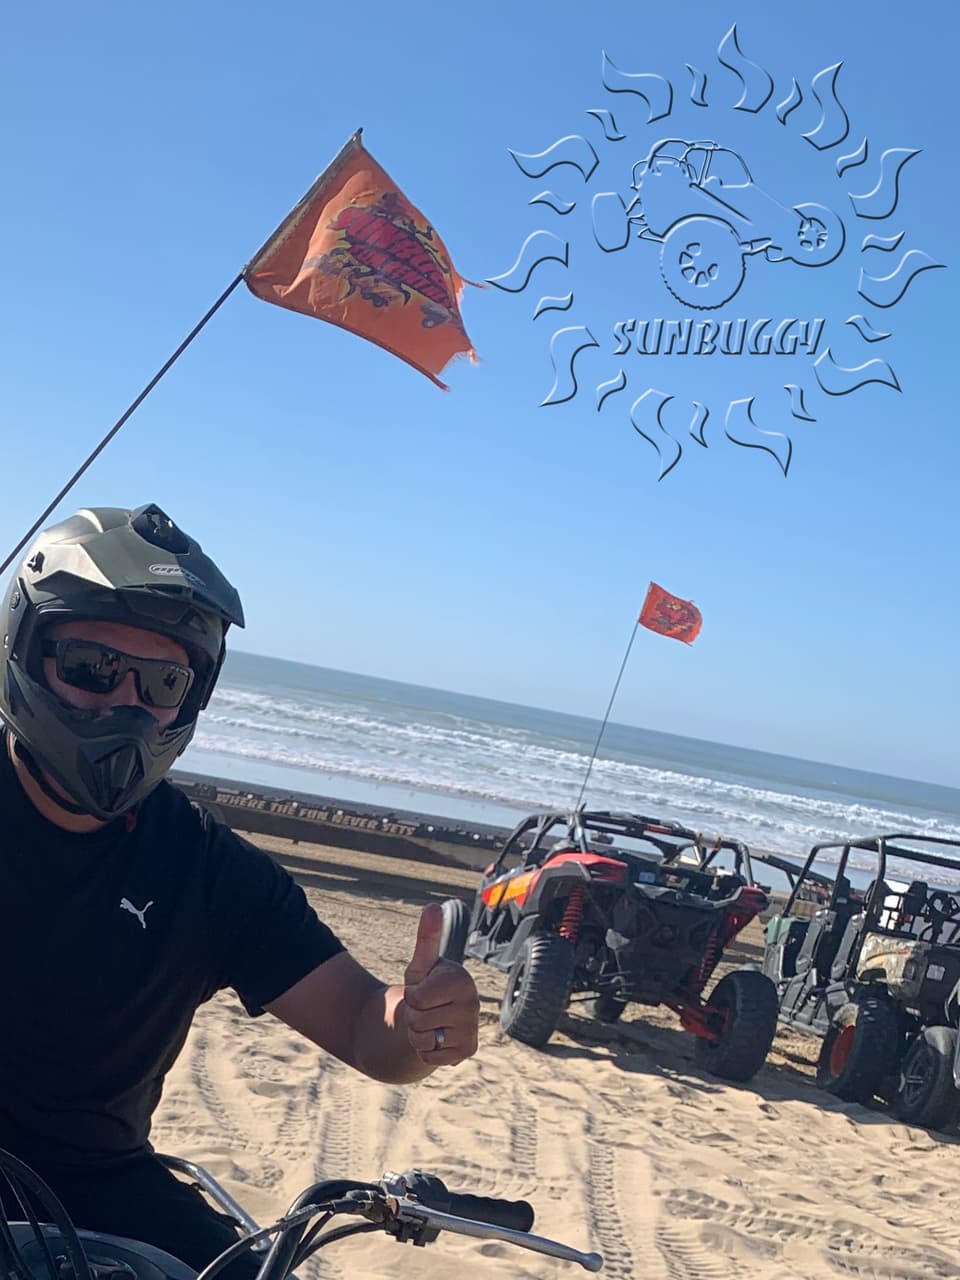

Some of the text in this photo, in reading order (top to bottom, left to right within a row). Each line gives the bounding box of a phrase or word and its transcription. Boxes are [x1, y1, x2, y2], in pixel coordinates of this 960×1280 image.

[216, 793, 266, 810] WHERE
[270, 801, 296, 815] THE
[332, 812, 378, 829] NEVER
[382, 821, 416, 836] SETS
